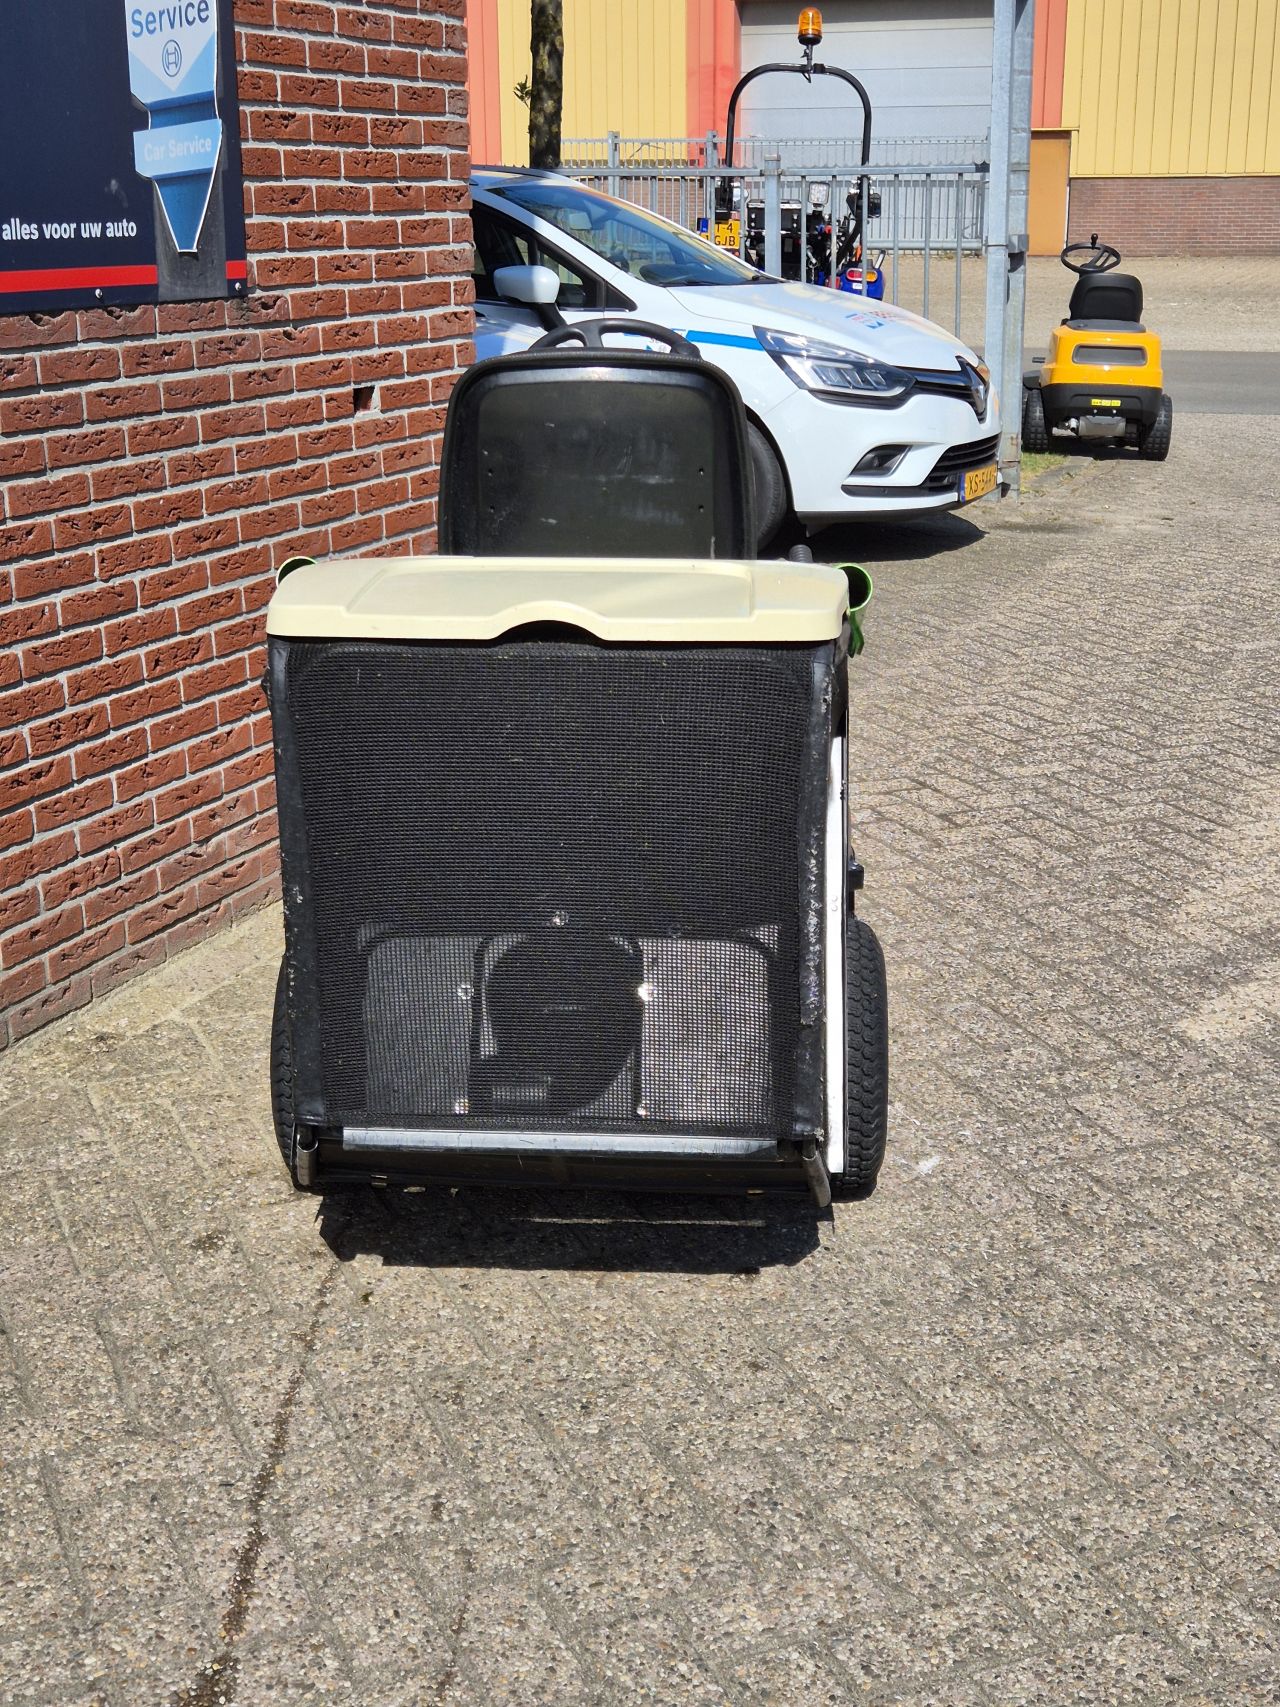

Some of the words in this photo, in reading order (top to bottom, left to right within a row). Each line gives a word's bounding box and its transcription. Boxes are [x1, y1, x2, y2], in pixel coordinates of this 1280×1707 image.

[131, 0, 210, 38] Service
[143, 143, 165, 161] Car
[168, 135, 212, 158] Service
[1, 217, 39, 240] alles
[42, 222, 77, 239] voor
[80, 222, 102, 238] uw
[105, 218, 137, 238] auto
